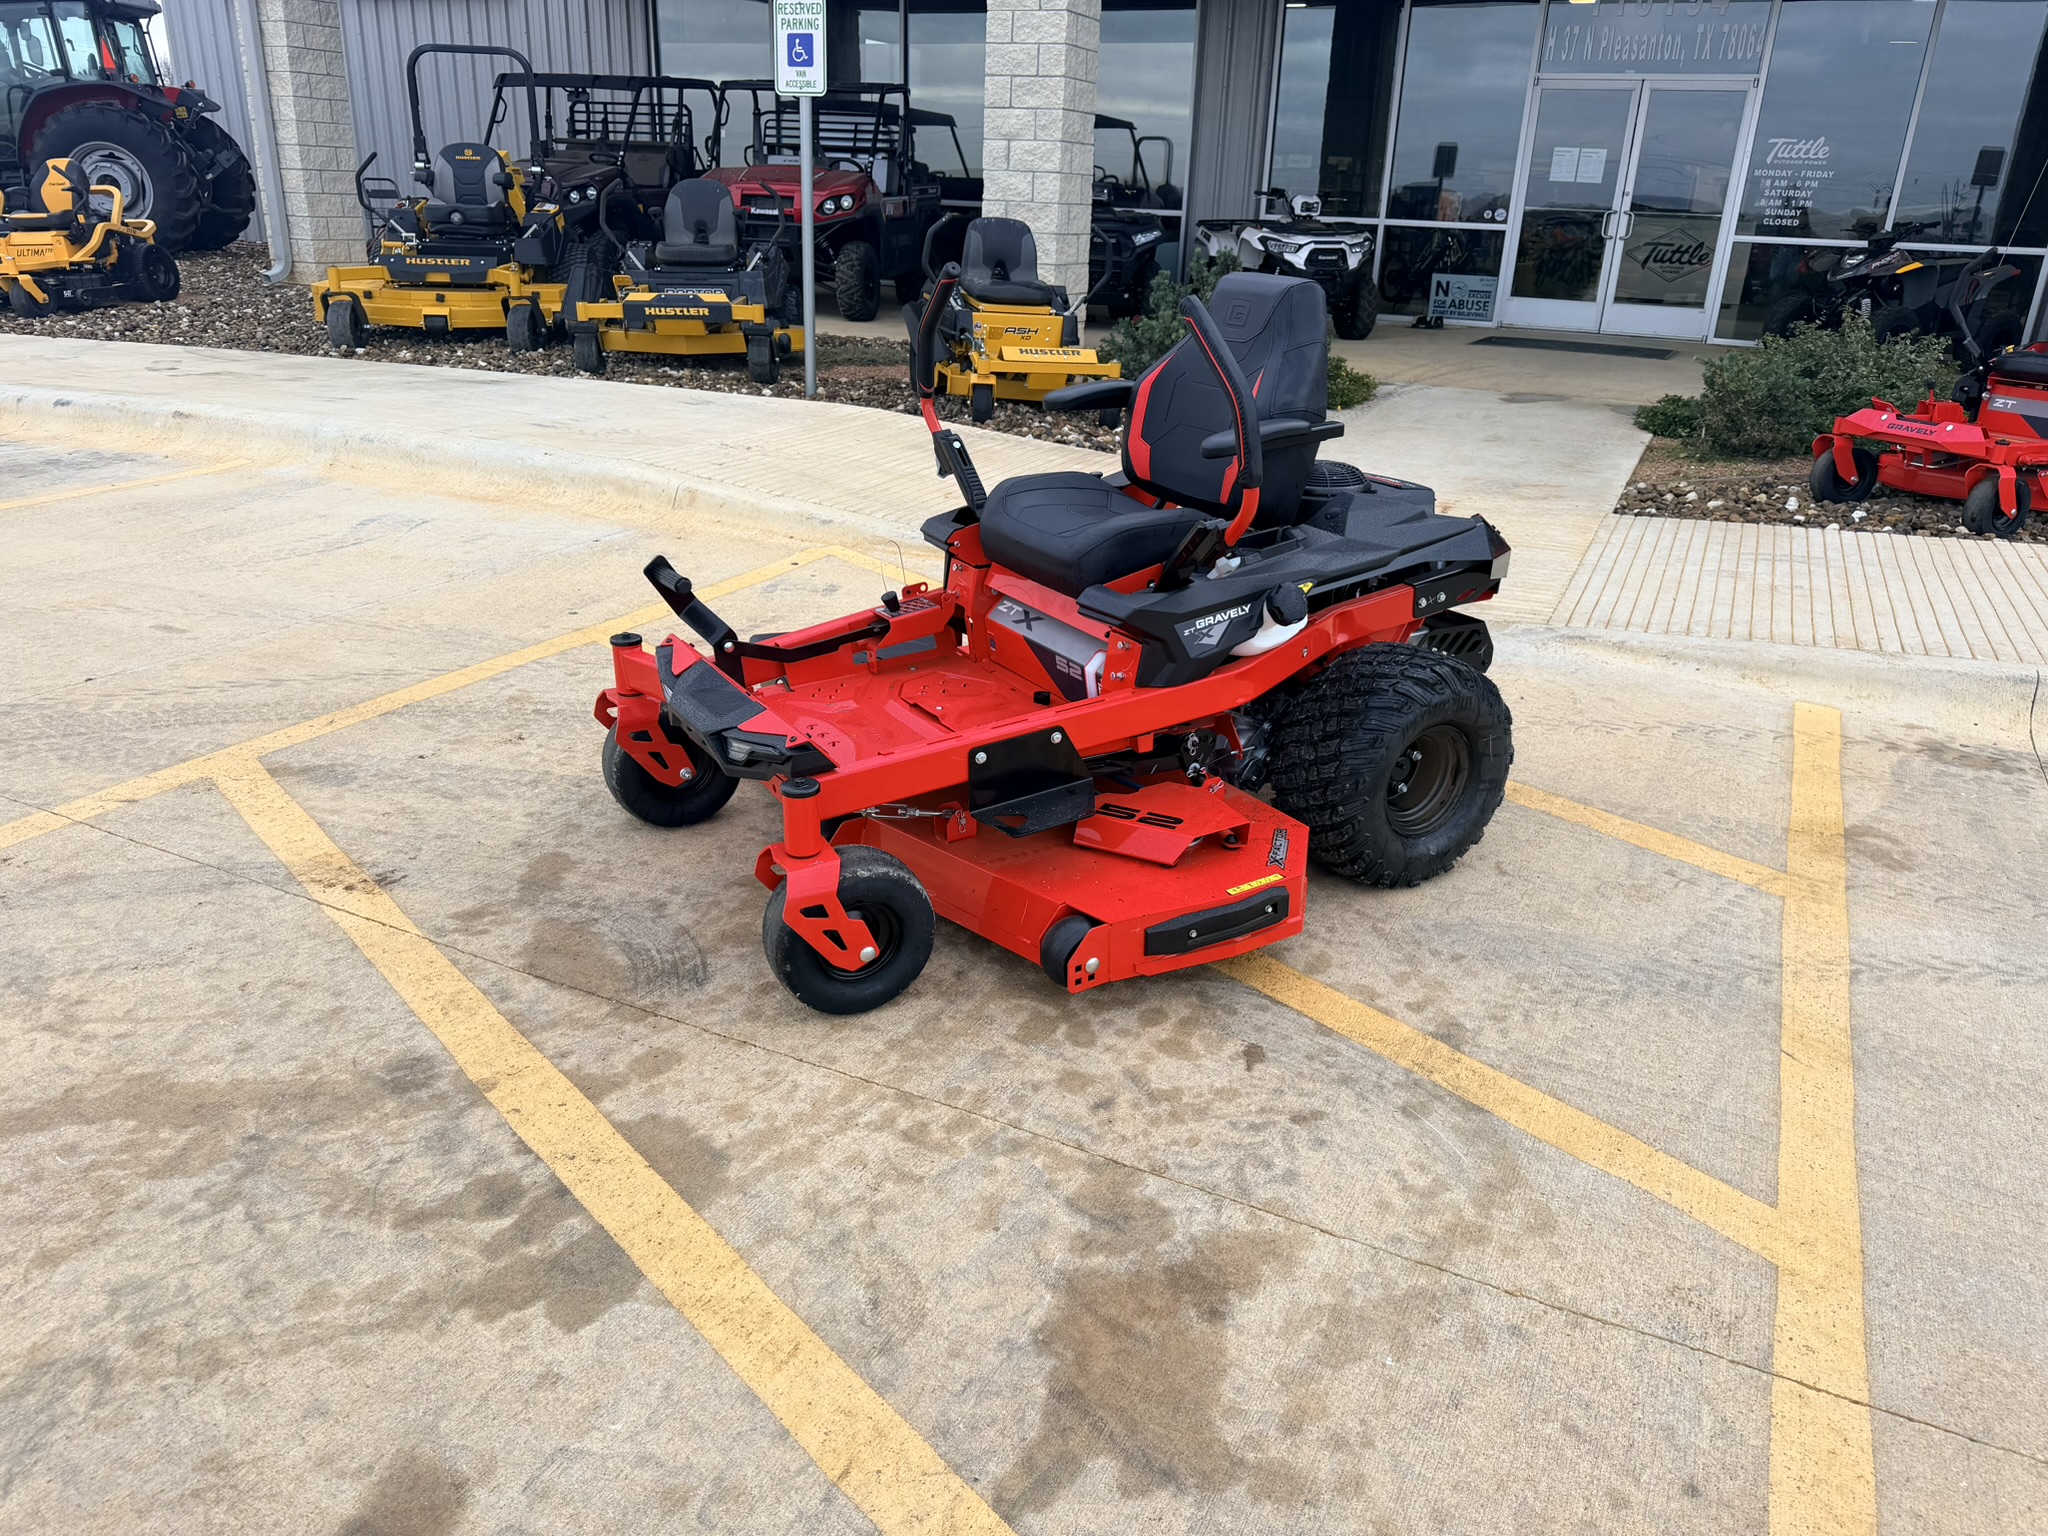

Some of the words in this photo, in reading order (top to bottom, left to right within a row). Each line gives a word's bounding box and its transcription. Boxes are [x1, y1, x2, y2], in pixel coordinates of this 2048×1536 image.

[778, 2, 822, 15] RESERVED
[780, 17, 819, 30] PARKING
[1562, 25, 1581, 61] 37
[1583, 25, 1597, 61] N
[1598, 25, 1686, 68] Pleasanton,
[1694, 24, 1716, 60] TX
[795, 69, 807, 78] VAN
[785, 79, 817, 88] ACCESSIBLE
[1766, 136, 1830, 164] Tuttle
[1754, 169, 1793, 177] MONDAY
[1800, 170, 1835, 178] FRIDAY
[1764, 189, 1813, 198] SATURDAY
[1764, 208, 1802, 217] SUNDAY
[1763, 218, 1800, 226] CLOSED
[17, 248, 45, 257] ULTIMA
[1641, 241, 1710, 270] Tuttle
[405, 257, 471, 266] HUSTLER
[1447, 299, 1490, 311] ABUSE
[644, 307, 710, 316] HUSTLER
[1018, 348, 1081, 356] HUSTLER
[1992, 398, 2017, 409] ZT
[1886, 422, 1937, 436] GRAVELY
[1195, 603, 1251, 629] GRAVELY
[1183, 627, 1196, 636] ZT
[1055, 655, 1083, 681] 52
[1096, 803, 1185, 830] 52
[1269, 828, 1284, 867] X-FACTOR
